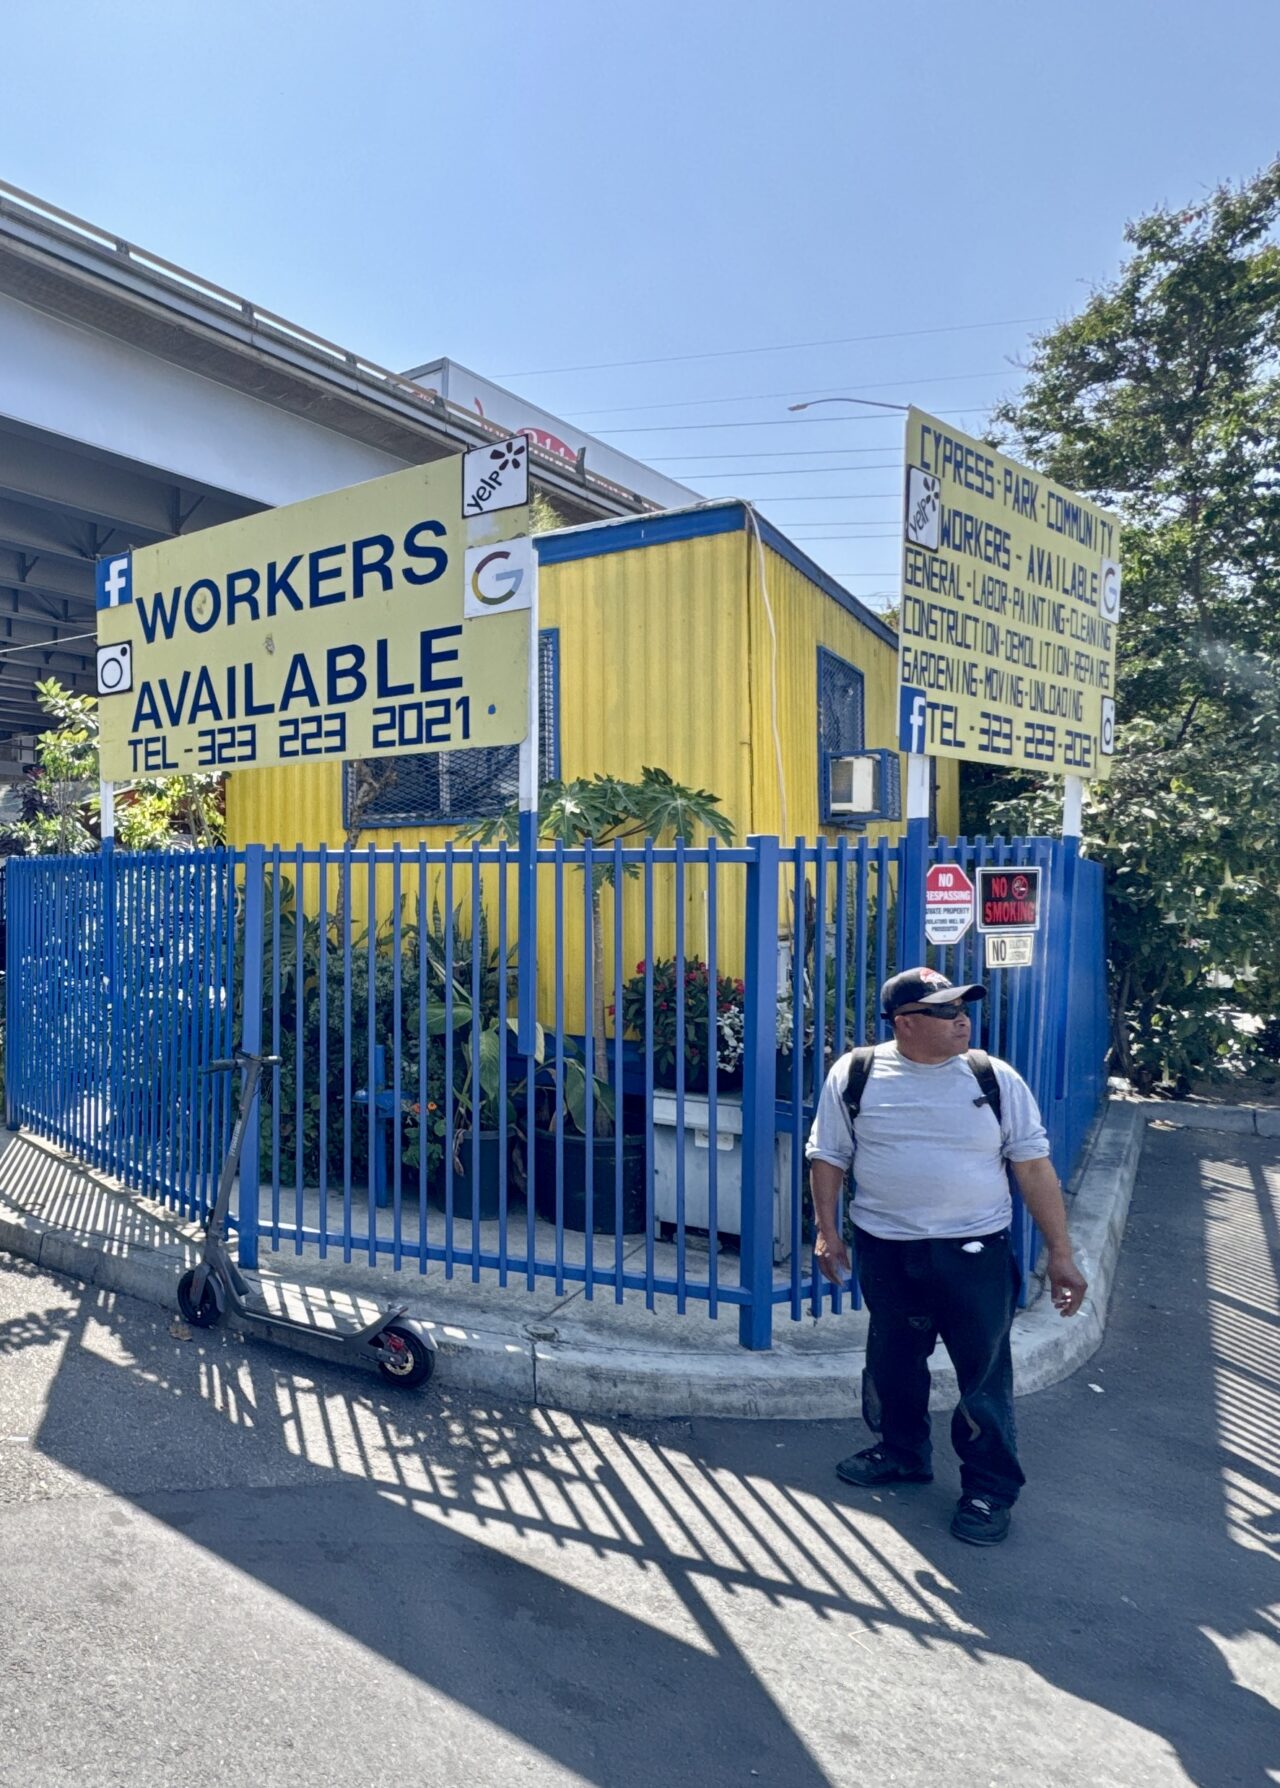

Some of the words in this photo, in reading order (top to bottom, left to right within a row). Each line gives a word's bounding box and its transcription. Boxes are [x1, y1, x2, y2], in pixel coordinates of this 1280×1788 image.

[466, 469, 503, 513] yelp
[941, 504, 1011, 571] WORKERS
[1027, 544, 1098, 607] AVAILABLE
[135, 519, 449, 643] WORKERS
[131, 624, 463, 733] AVAILABLE
[128, 738, 179, 772] TEL
[198, 723, 256, 767] 323
[279, 712, 346, 759] 223
[372, 695, 470, 749] 2021
[927, 701, 966, 749] TEL
[938, 873, 954, 887] NO
[991, 877, 1008, 898] NO
[984, 901, 1035, 923] SMOKING
[992, 940, 1007, 961] NO
